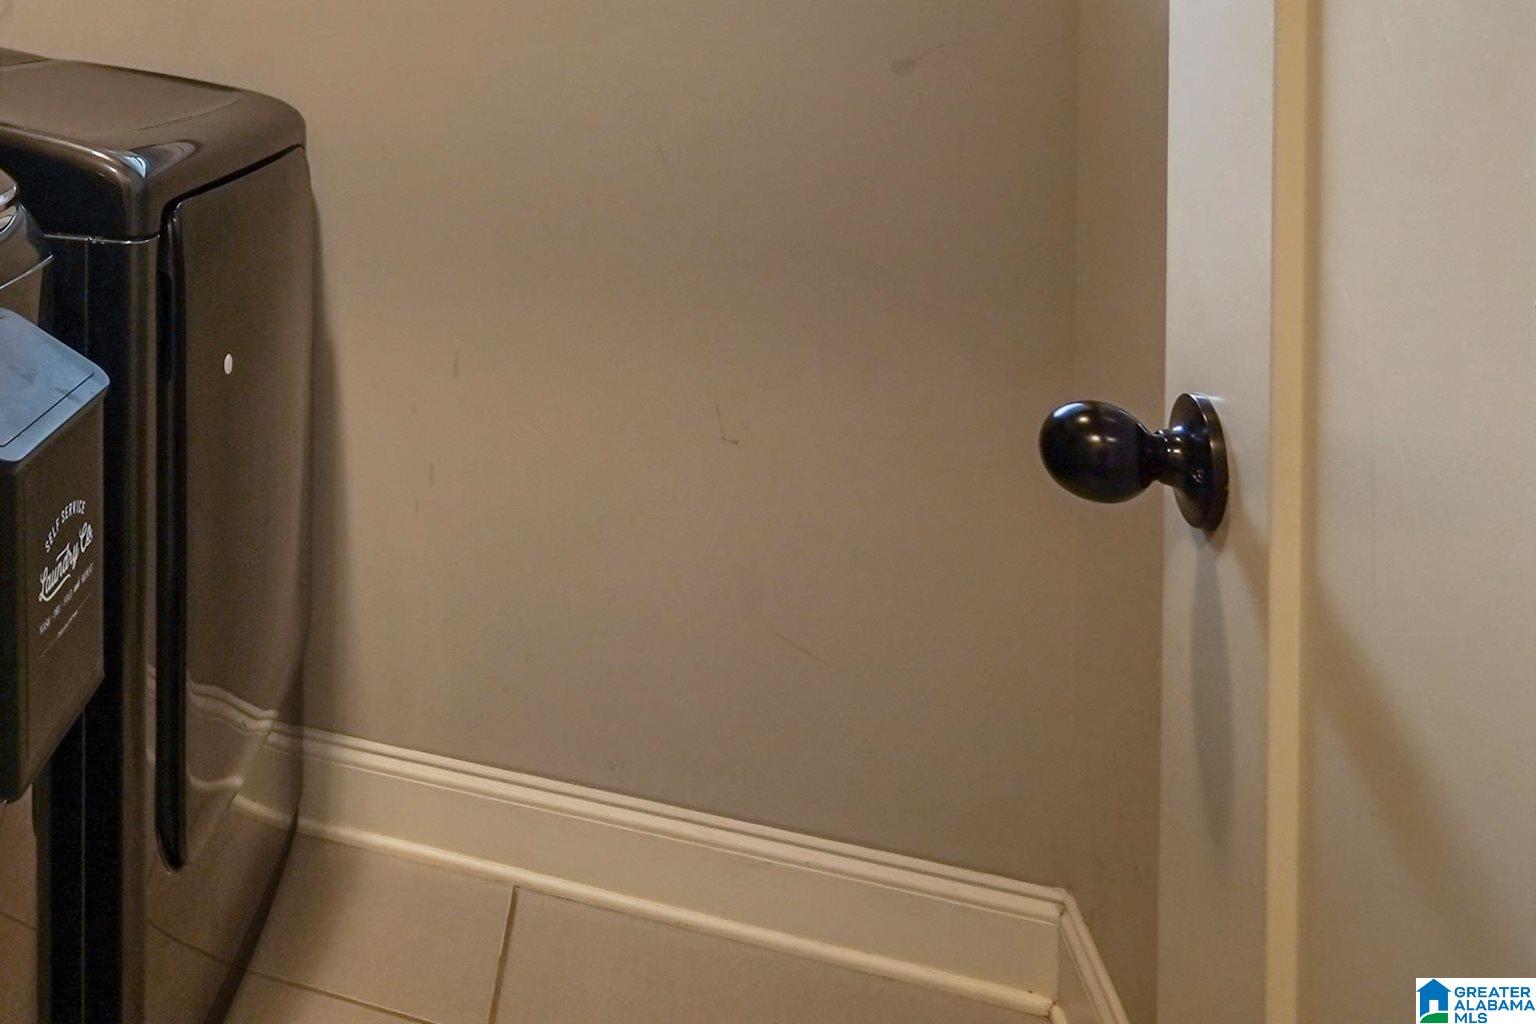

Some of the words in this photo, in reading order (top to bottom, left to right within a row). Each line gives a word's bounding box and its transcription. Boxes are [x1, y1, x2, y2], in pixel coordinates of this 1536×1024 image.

[44, 517, 61, 553] SELF
[60, 499, 87, 524] SERVICE
[38, 541, 80, 602] Laundry
